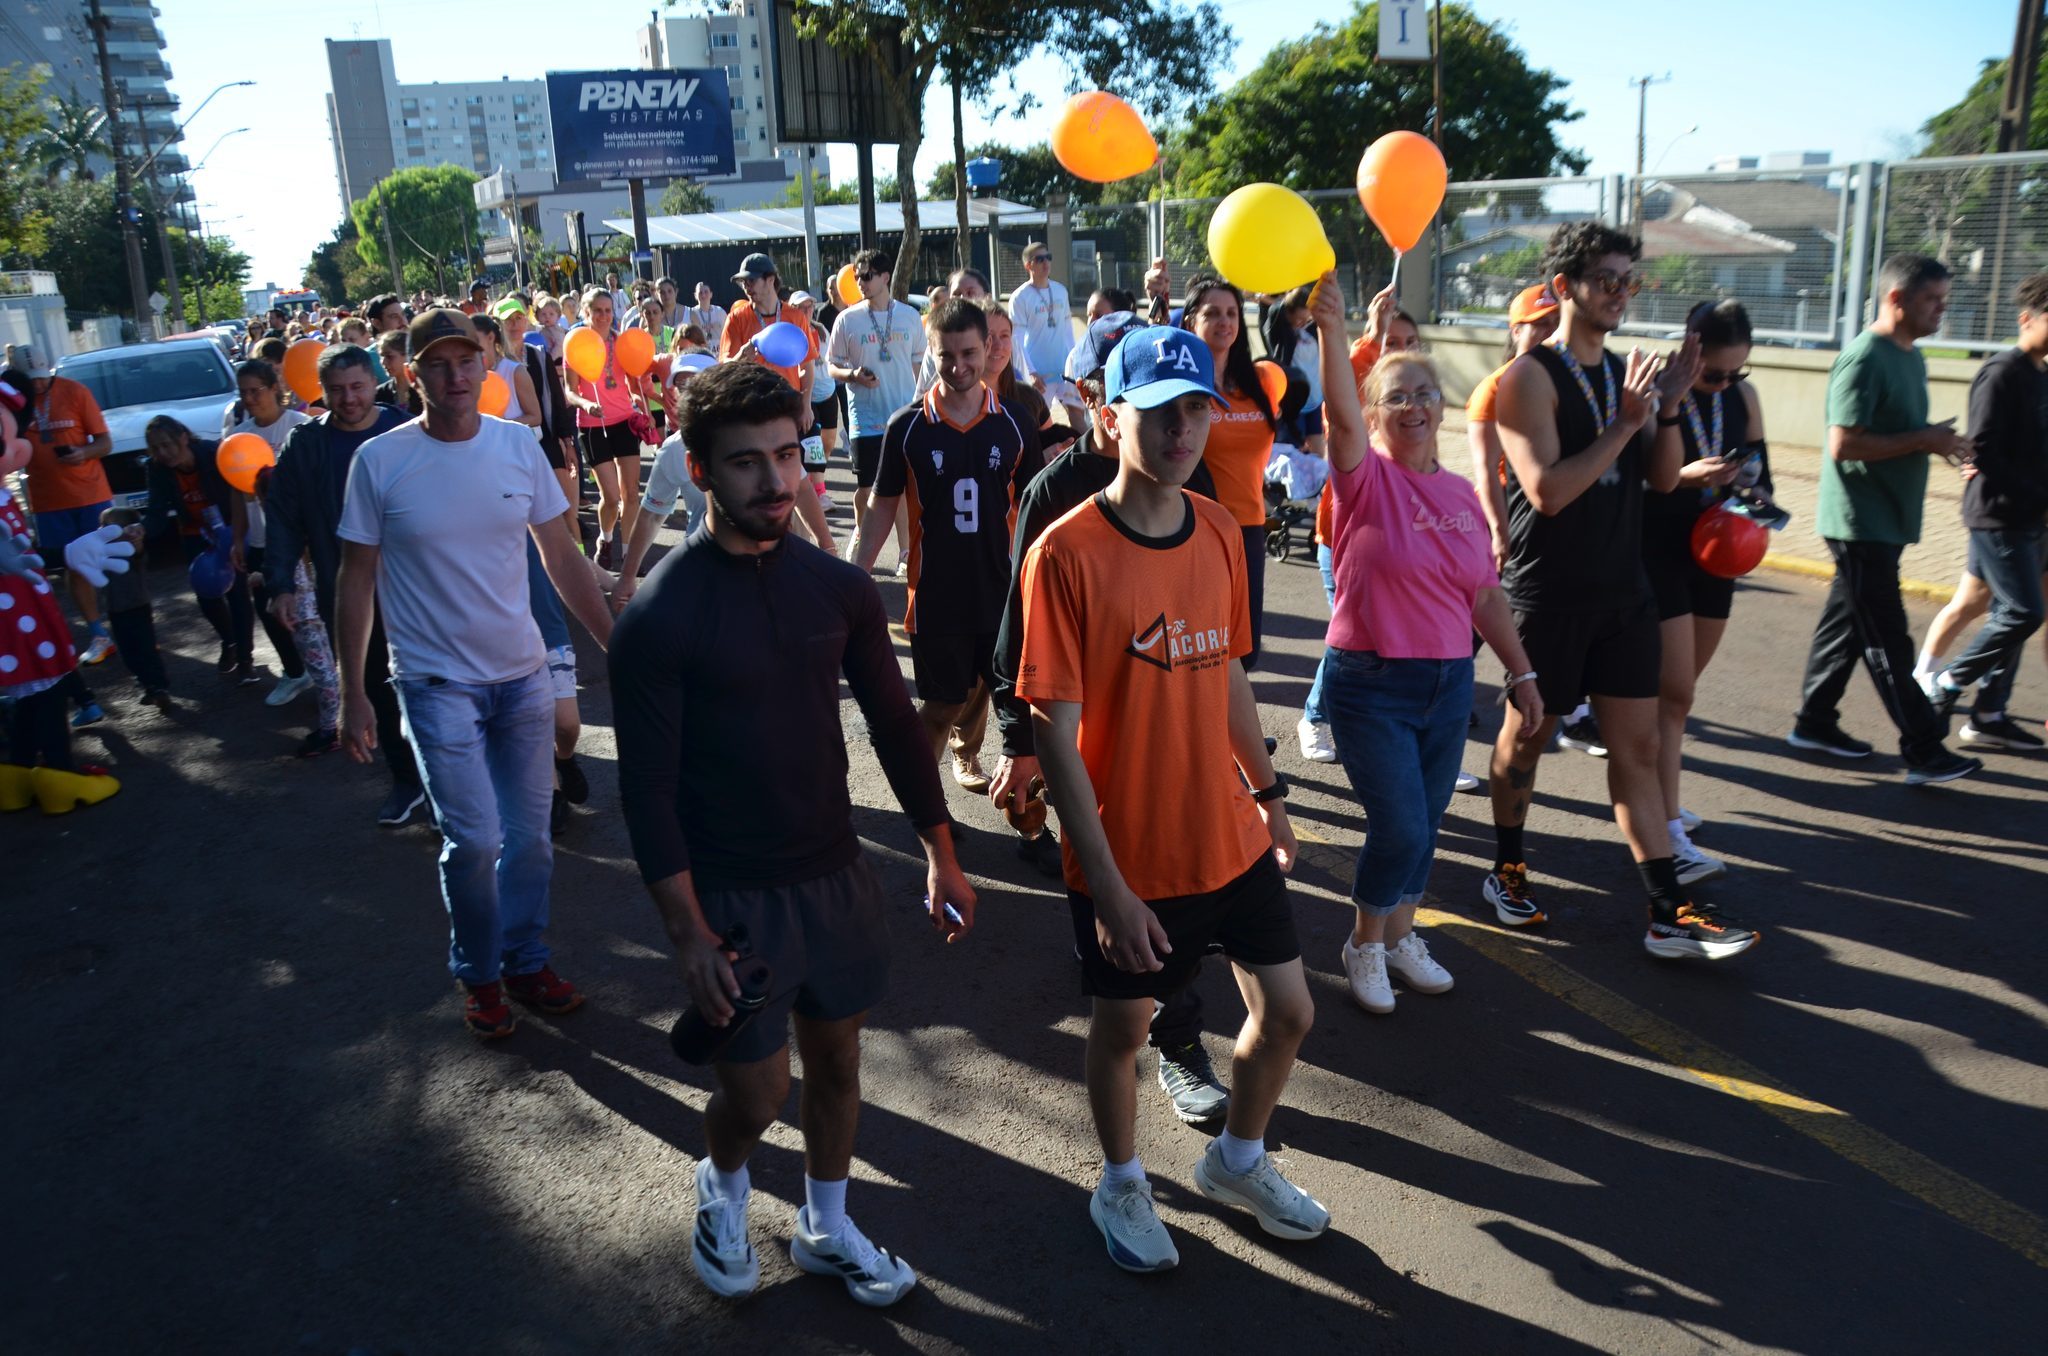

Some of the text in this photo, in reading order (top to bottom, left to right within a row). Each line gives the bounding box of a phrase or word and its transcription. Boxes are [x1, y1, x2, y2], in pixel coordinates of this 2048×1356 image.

[579, 78, 700, 111] PBNEW
[610, 109, 703, 124] SISTEMAS
[603, 129, 684, 141] Soluções tecnológicas
[617, 139, 649, 149] produtos
[1153, 338, 1199, 374] LA
[1225, 410, 1265, 422] CRESO
[954, 478, 979, 533] 9
